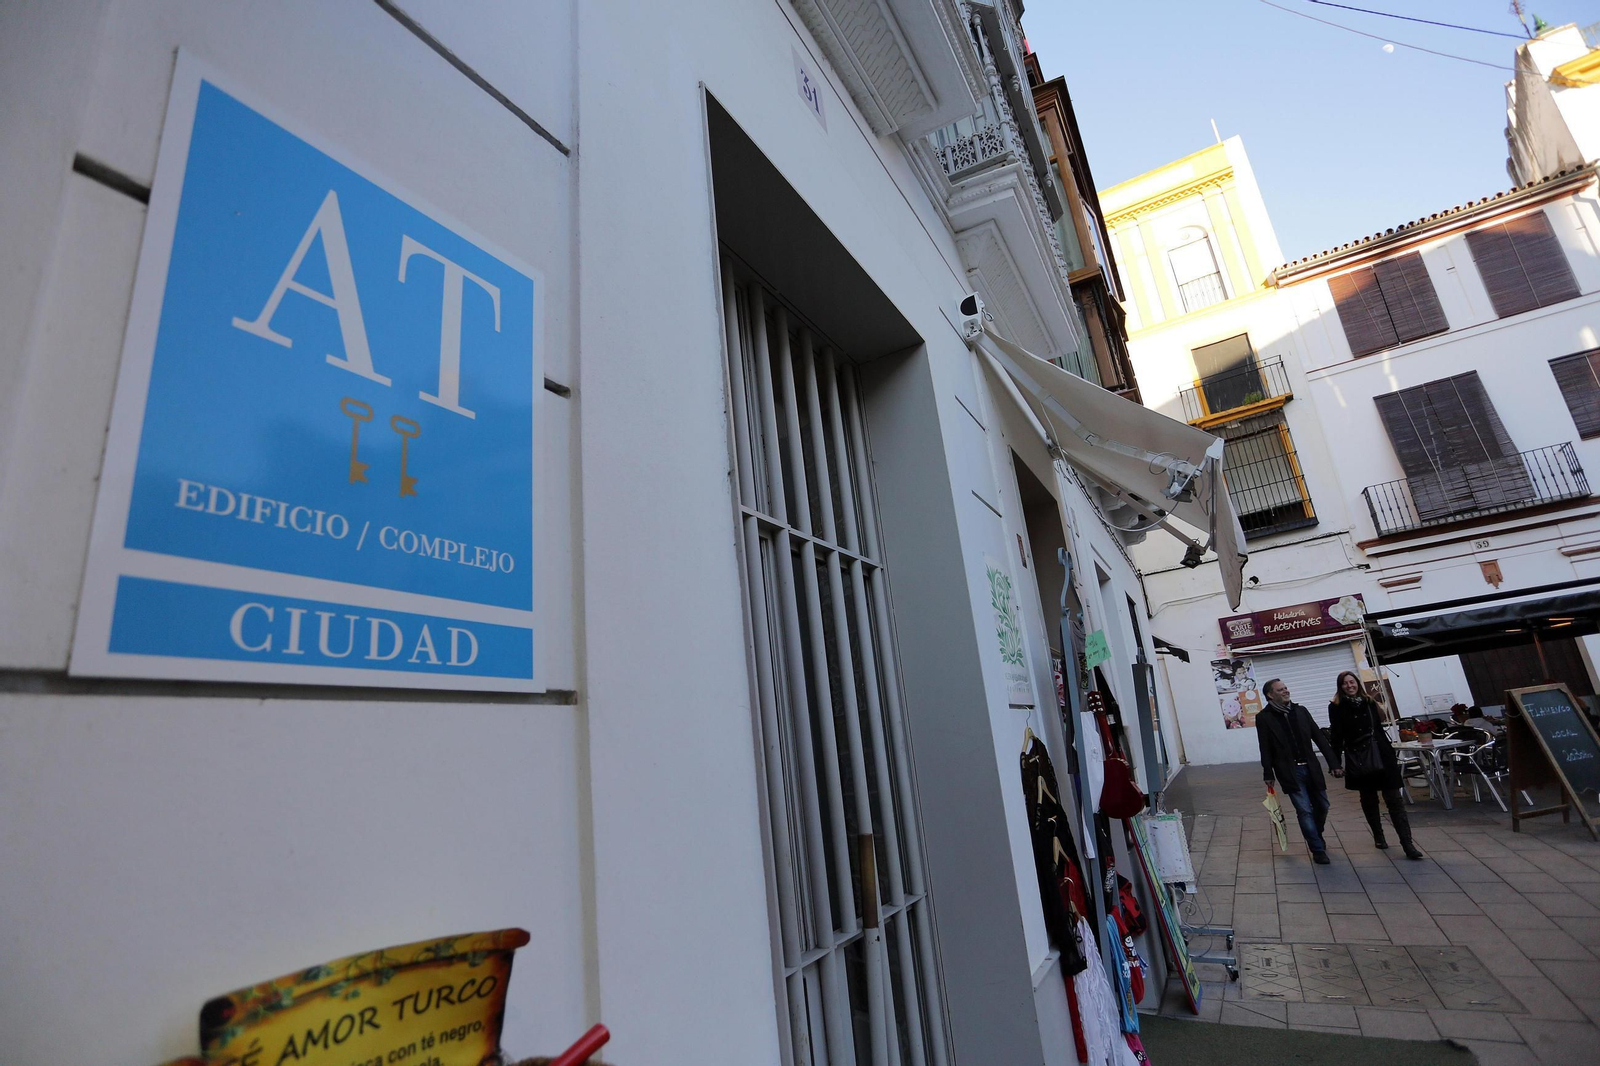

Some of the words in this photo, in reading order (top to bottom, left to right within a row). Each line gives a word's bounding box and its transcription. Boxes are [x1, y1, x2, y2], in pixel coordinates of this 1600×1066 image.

[232, 189, 500, 420] AT
[175, 478, 350, 540] EDIFICIO
[379, 525, 515, 574] COMPLEJO
[229, 602, 480, 667] CIUDAD
[1229, 622, 1252, 633] CARTE
[1263, 616, 1322, 634] PLACENTINES
[275, 1006, 381, 1066] AMOR
[393, 975, 499, 1021] TURCO
[388, 1042, 417, 1064] con
[421, 1031, 436, 1051] té
[440, 1019, 486, 1045] negro,
